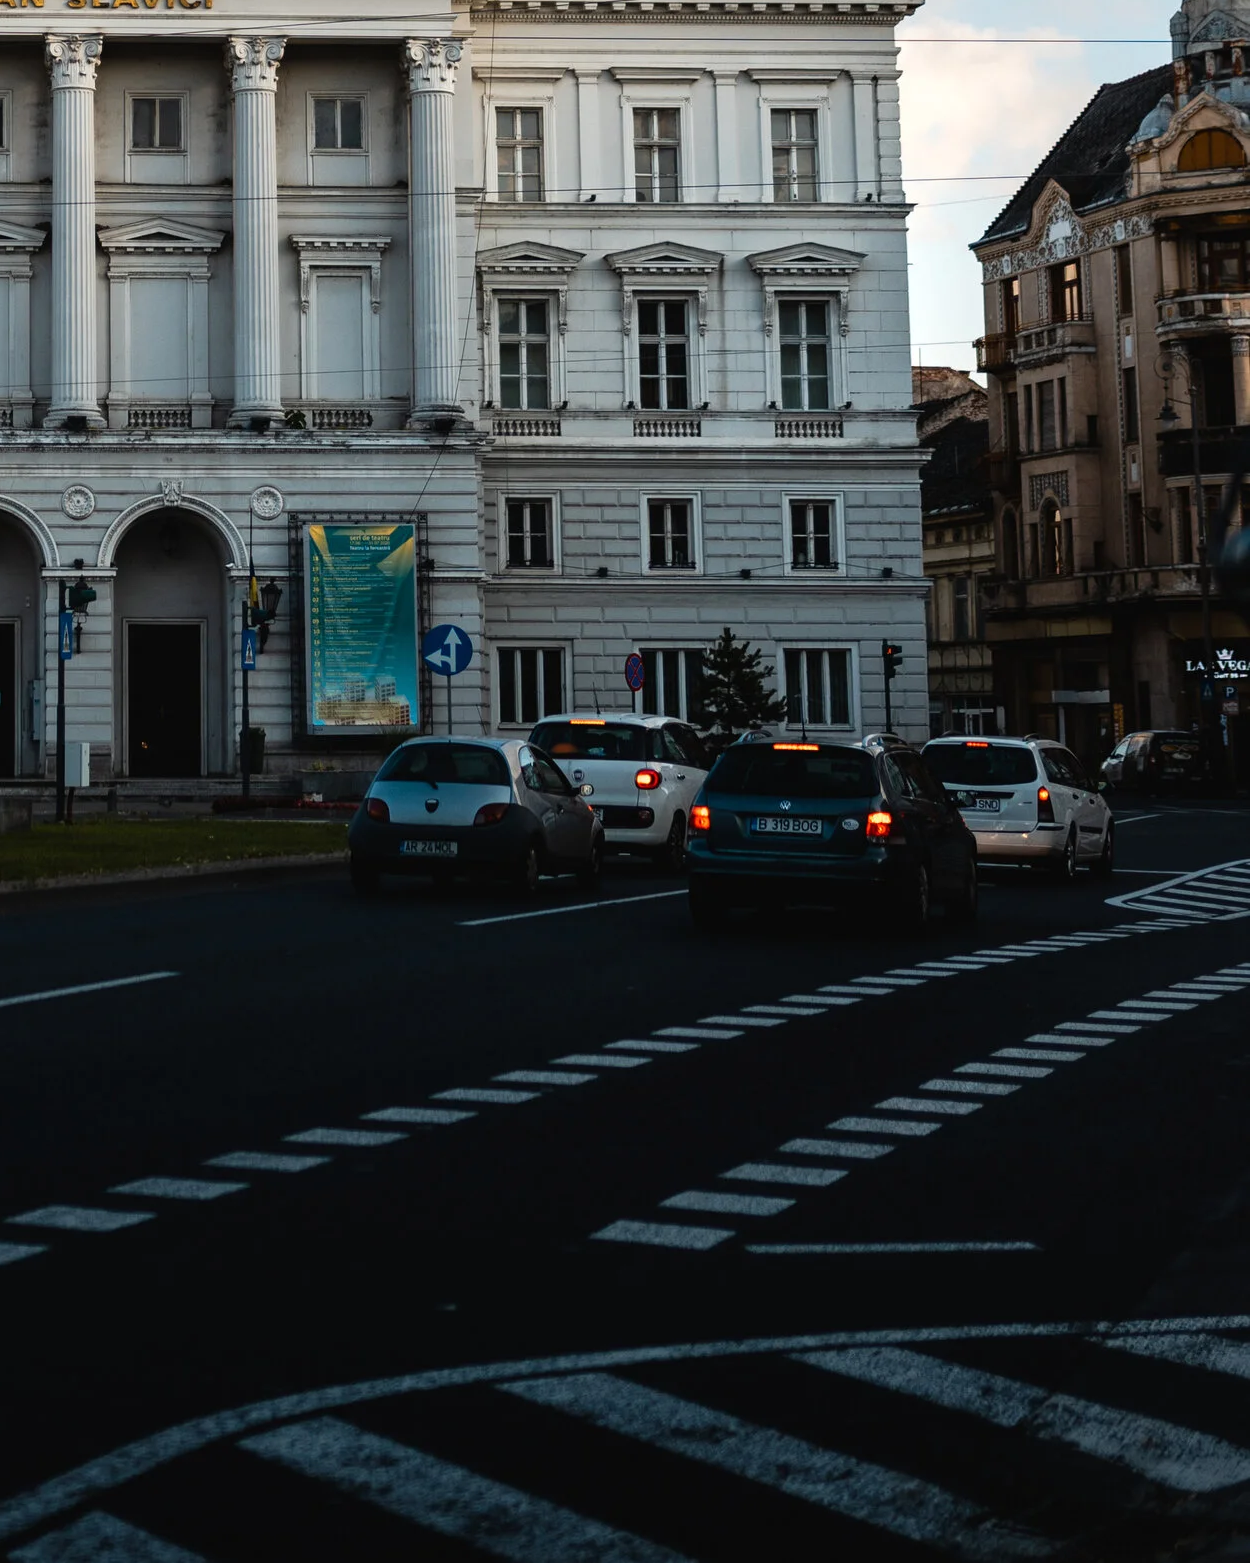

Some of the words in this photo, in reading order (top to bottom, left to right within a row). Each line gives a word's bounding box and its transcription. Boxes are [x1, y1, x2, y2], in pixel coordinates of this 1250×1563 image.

[1186, 660, 1215, 671] LA
[978, 799, 998, 809] SND
[758, 818, 767, 830] B
[772, 819, 790, 831] 319
[792, 819, 819, 831] BOG
[405, 840, 418, 851] AR
[421, 841, 433, 852] 24
